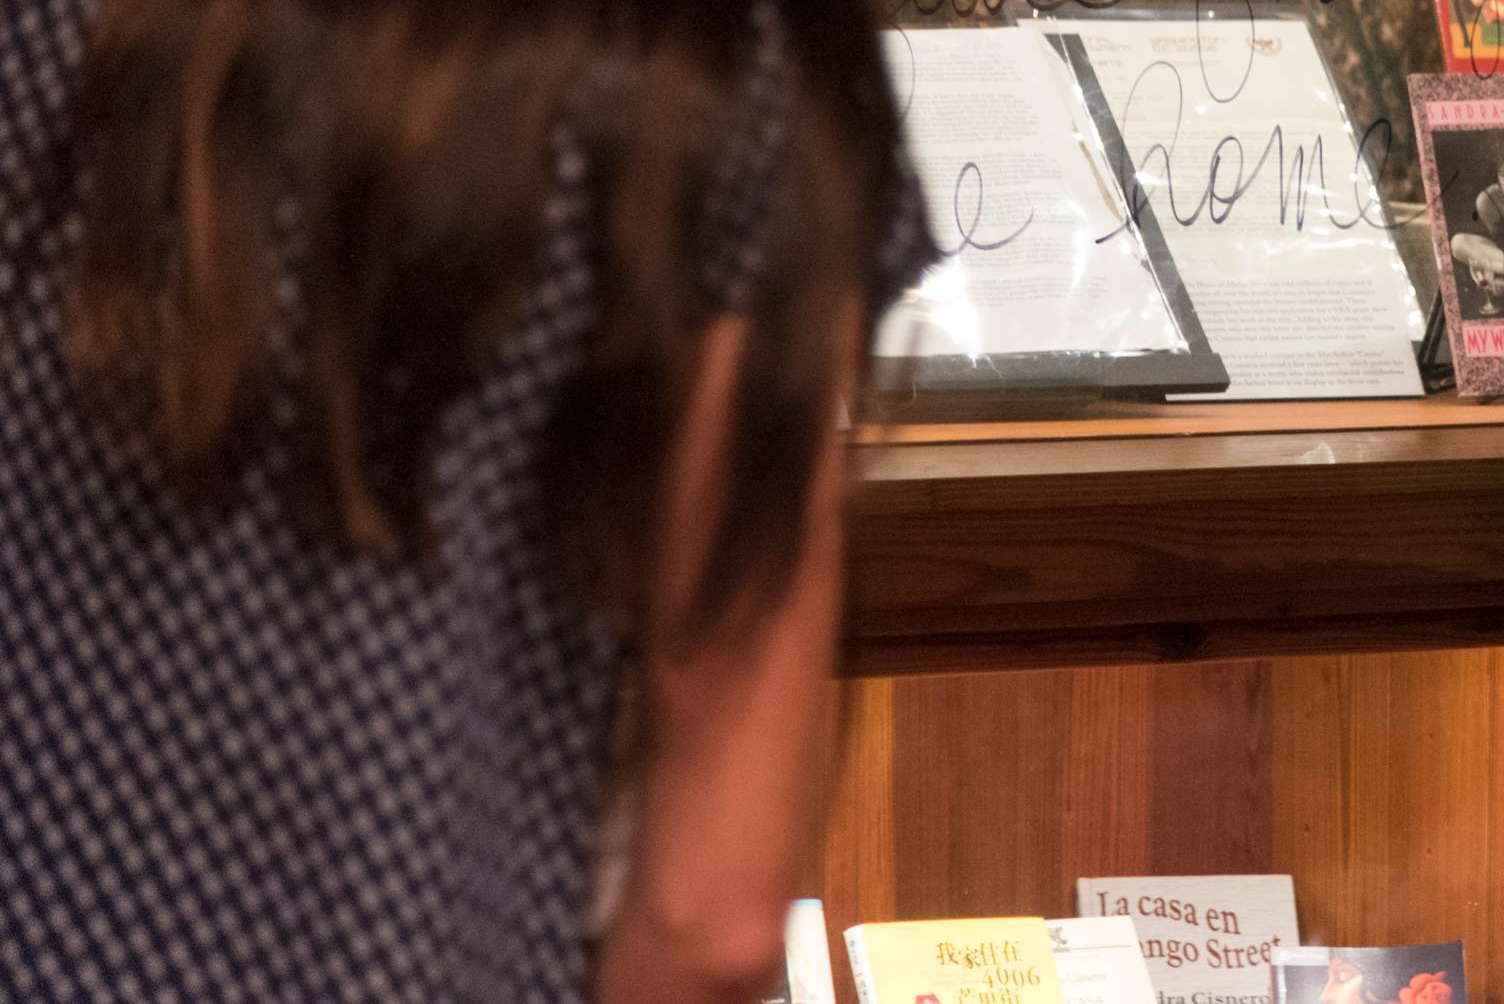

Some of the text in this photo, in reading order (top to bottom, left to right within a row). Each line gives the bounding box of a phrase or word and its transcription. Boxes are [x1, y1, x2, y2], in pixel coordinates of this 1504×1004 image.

[1466, 329, 1488, 355] MY
[1097, 891, 1242, 935] La casa en
